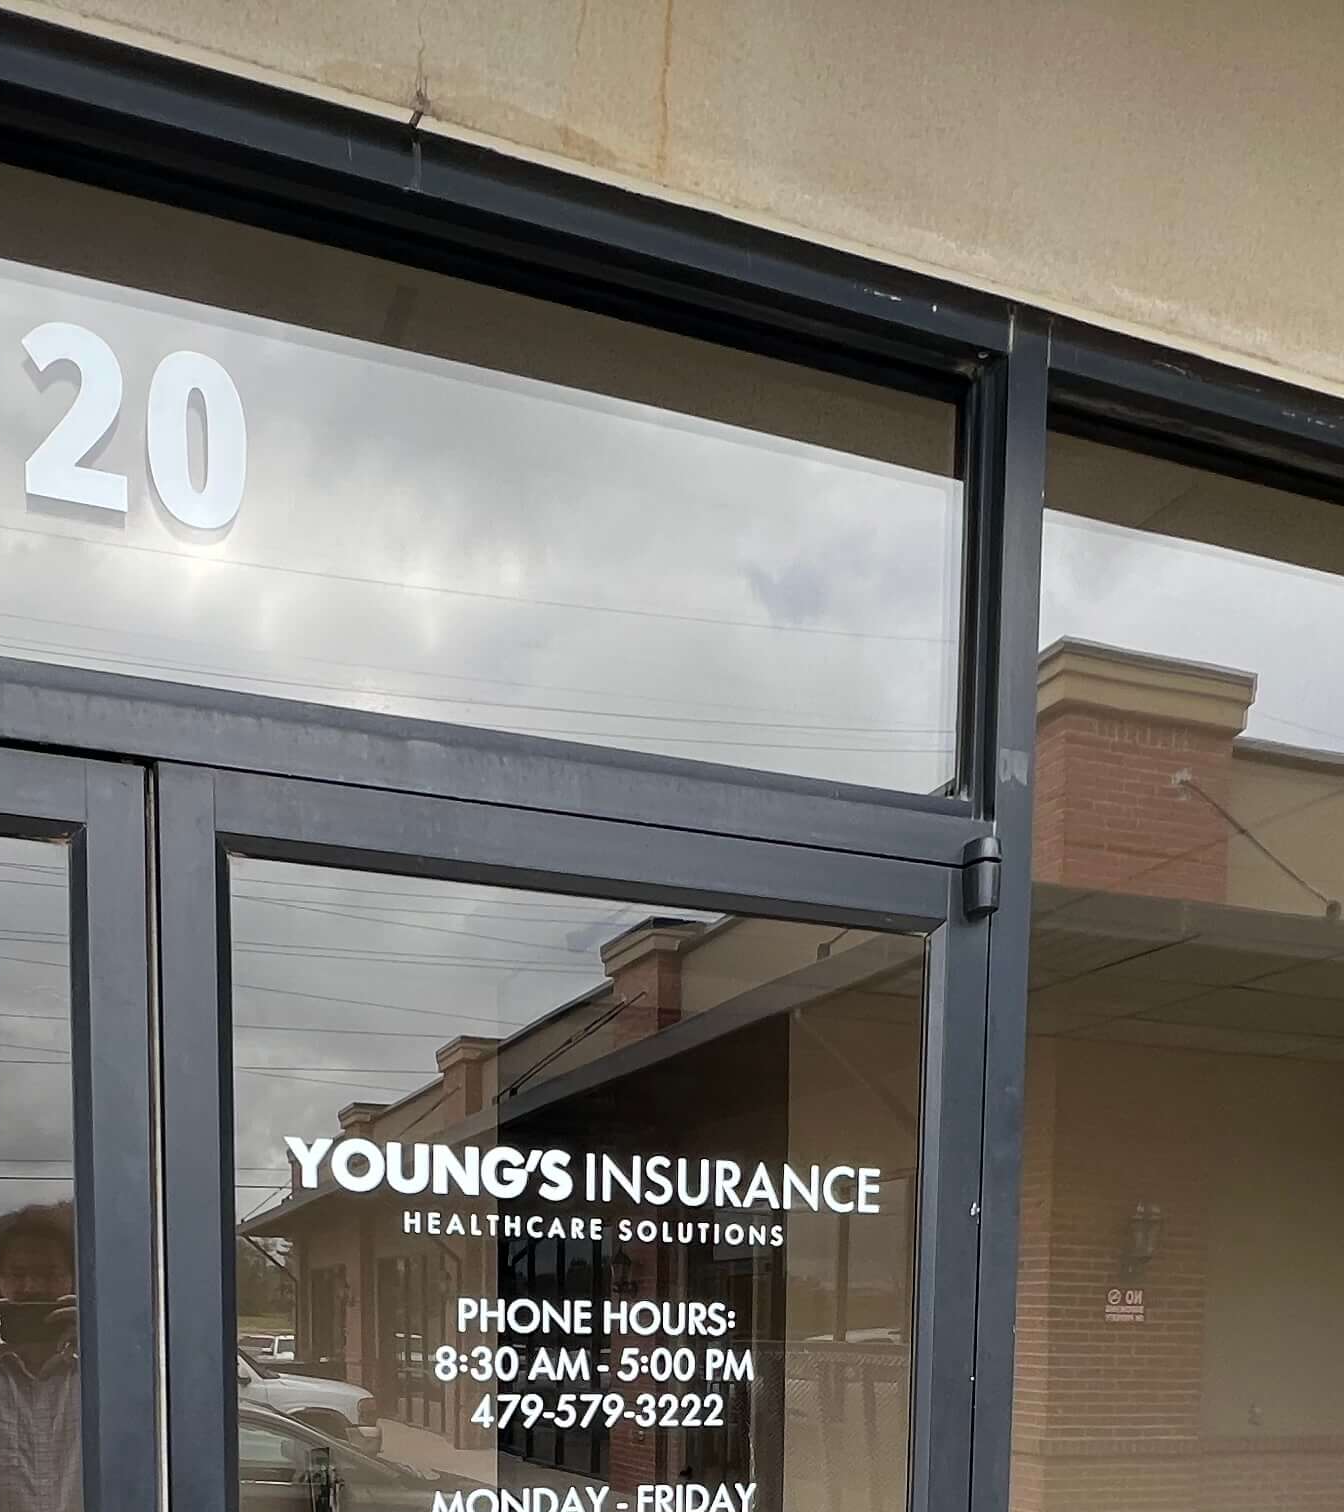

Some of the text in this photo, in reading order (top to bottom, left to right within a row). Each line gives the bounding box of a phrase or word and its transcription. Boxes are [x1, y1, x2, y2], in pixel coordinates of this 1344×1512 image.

[21, 320, 248, 530] 20
[283, 1135, 882, 1213] YOUNG'S INSURANCE
[403, 1211, 784, 1247] HEALTHCARE SOLUTIONS
[457, 1298, 737, 1337] PHONE HOURS:
[434, 1345, 755, 1382] 8:30 AM - 5:00 PM
[470, 1393, 725, 1429] 479-579-3222
[616, 1502, 628, 1510] -
